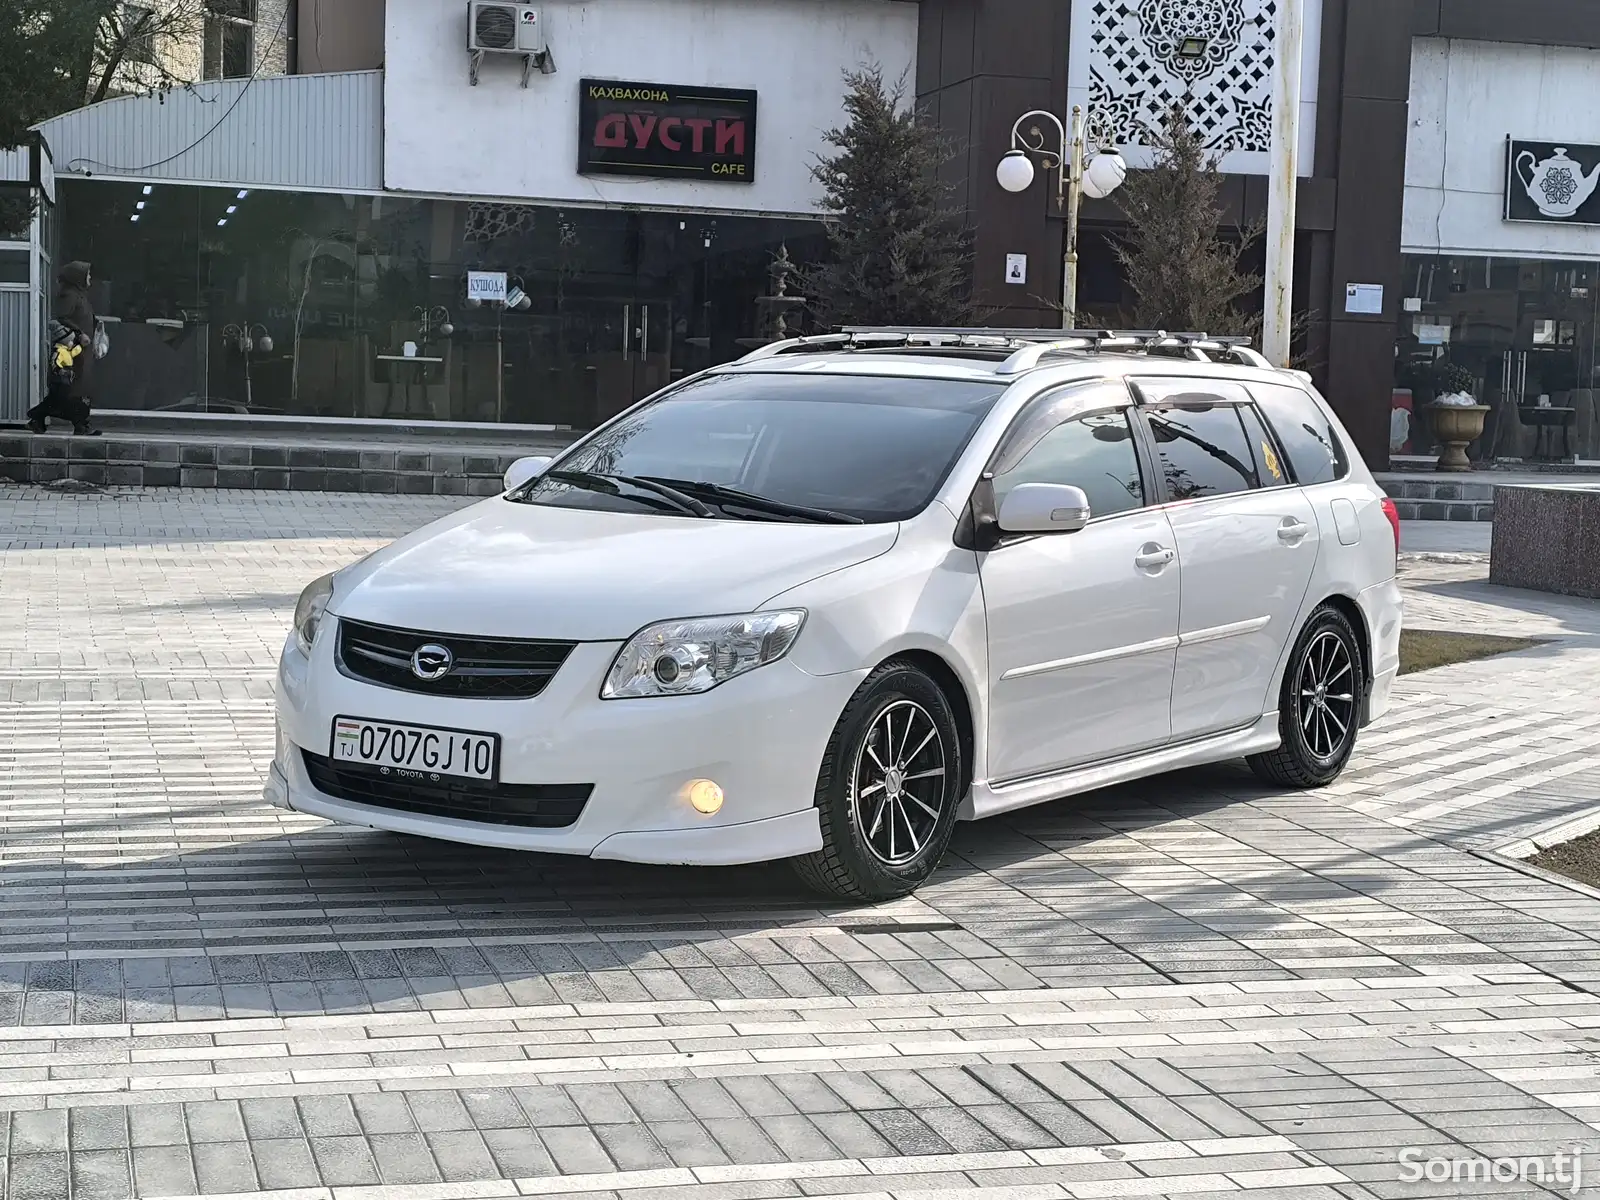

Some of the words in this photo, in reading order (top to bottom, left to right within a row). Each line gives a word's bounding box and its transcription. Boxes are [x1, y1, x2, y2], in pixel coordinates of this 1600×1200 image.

[711, 162, 745, 175] CAFE
[340, 742, 354, 757] TJ
[396, 768, 424, 779] TOYOTA
